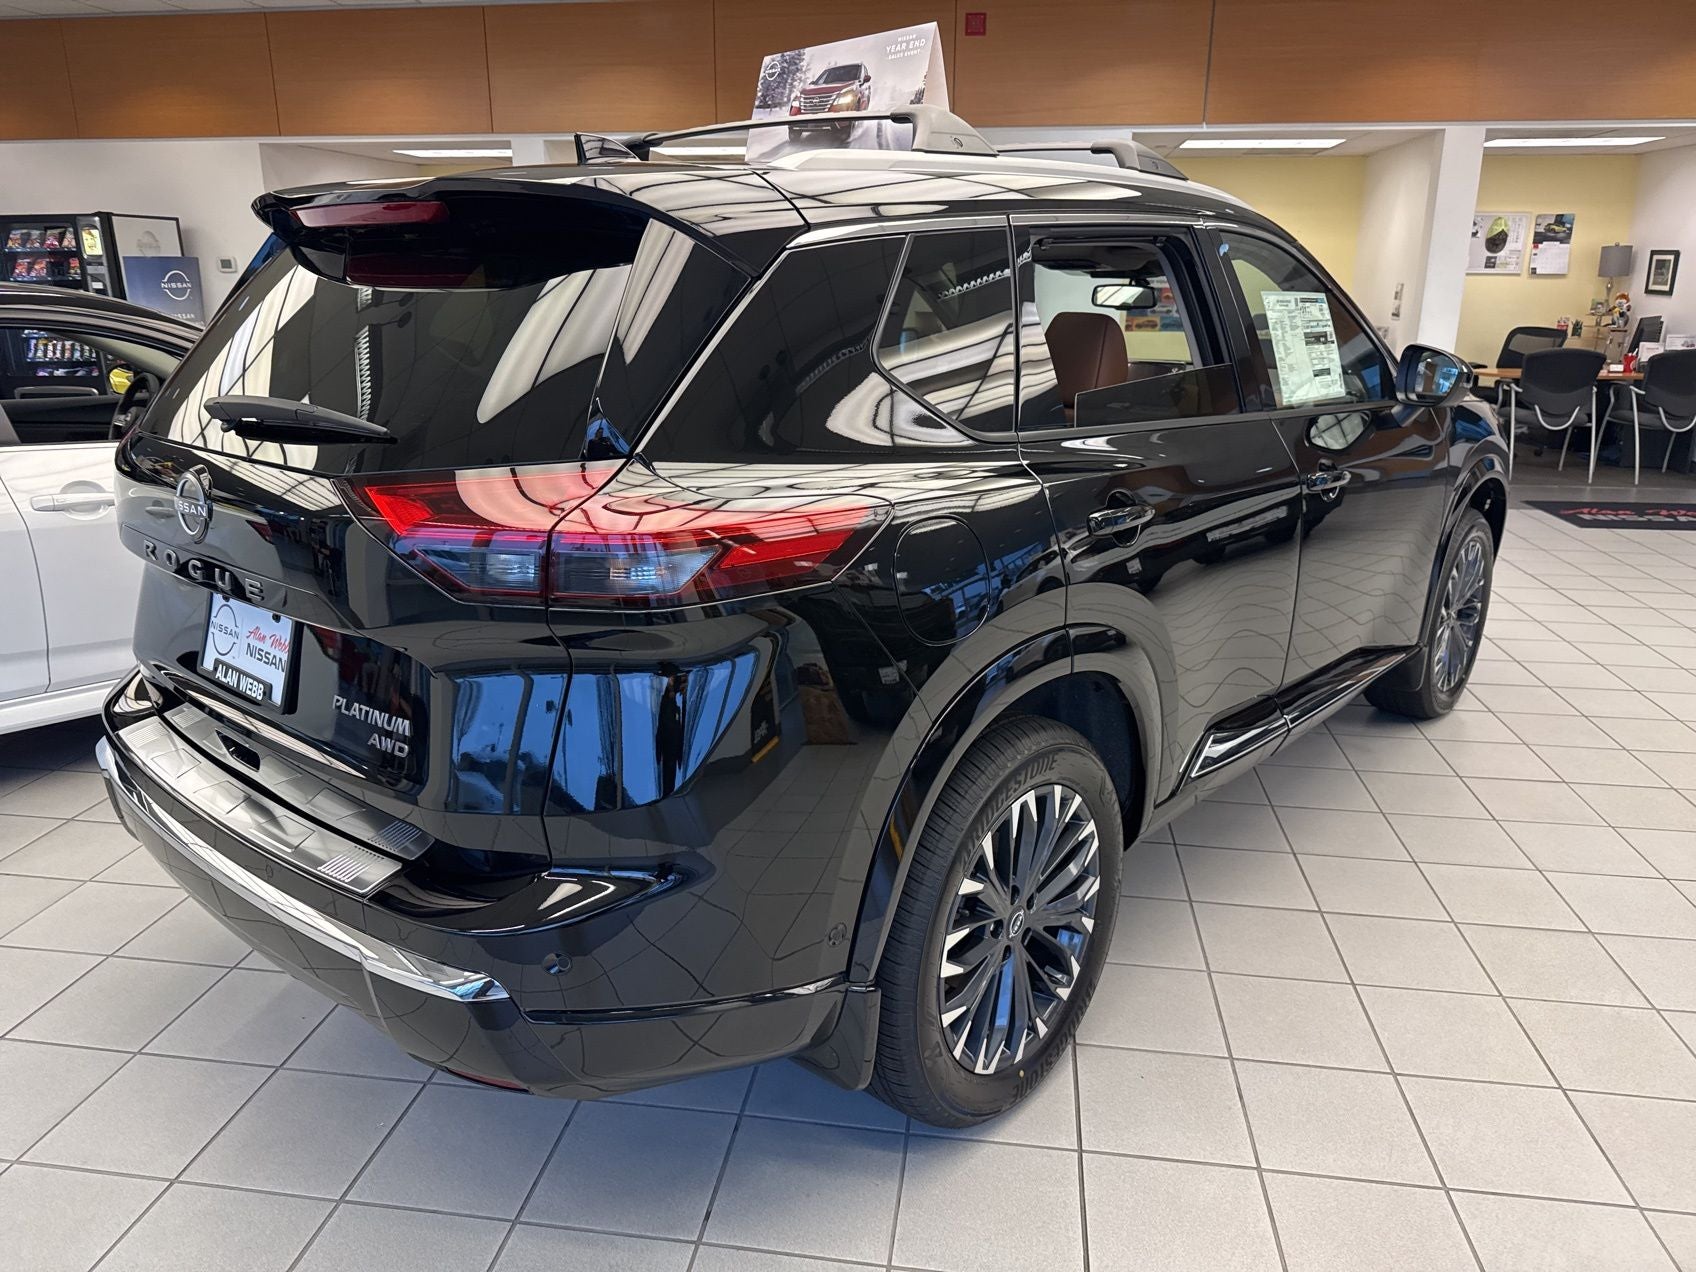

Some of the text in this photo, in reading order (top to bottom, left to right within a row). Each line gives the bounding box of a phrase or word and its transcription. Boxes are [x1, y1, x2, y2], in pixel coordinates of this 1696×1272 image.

[886, 39, 925, 53] YEAR END
[143, 540, 265, 601] ROGUE
[210, 620, 239, 640] NISSAN
[246, 625, 267, 644] Alan
[245, 642, 287, 673] NISSAN
[215, 664, 264, 700] ALAN WEBB
[332, 694, 411, 737] PLATINUM
[367, 733, 409, 758] AWD
